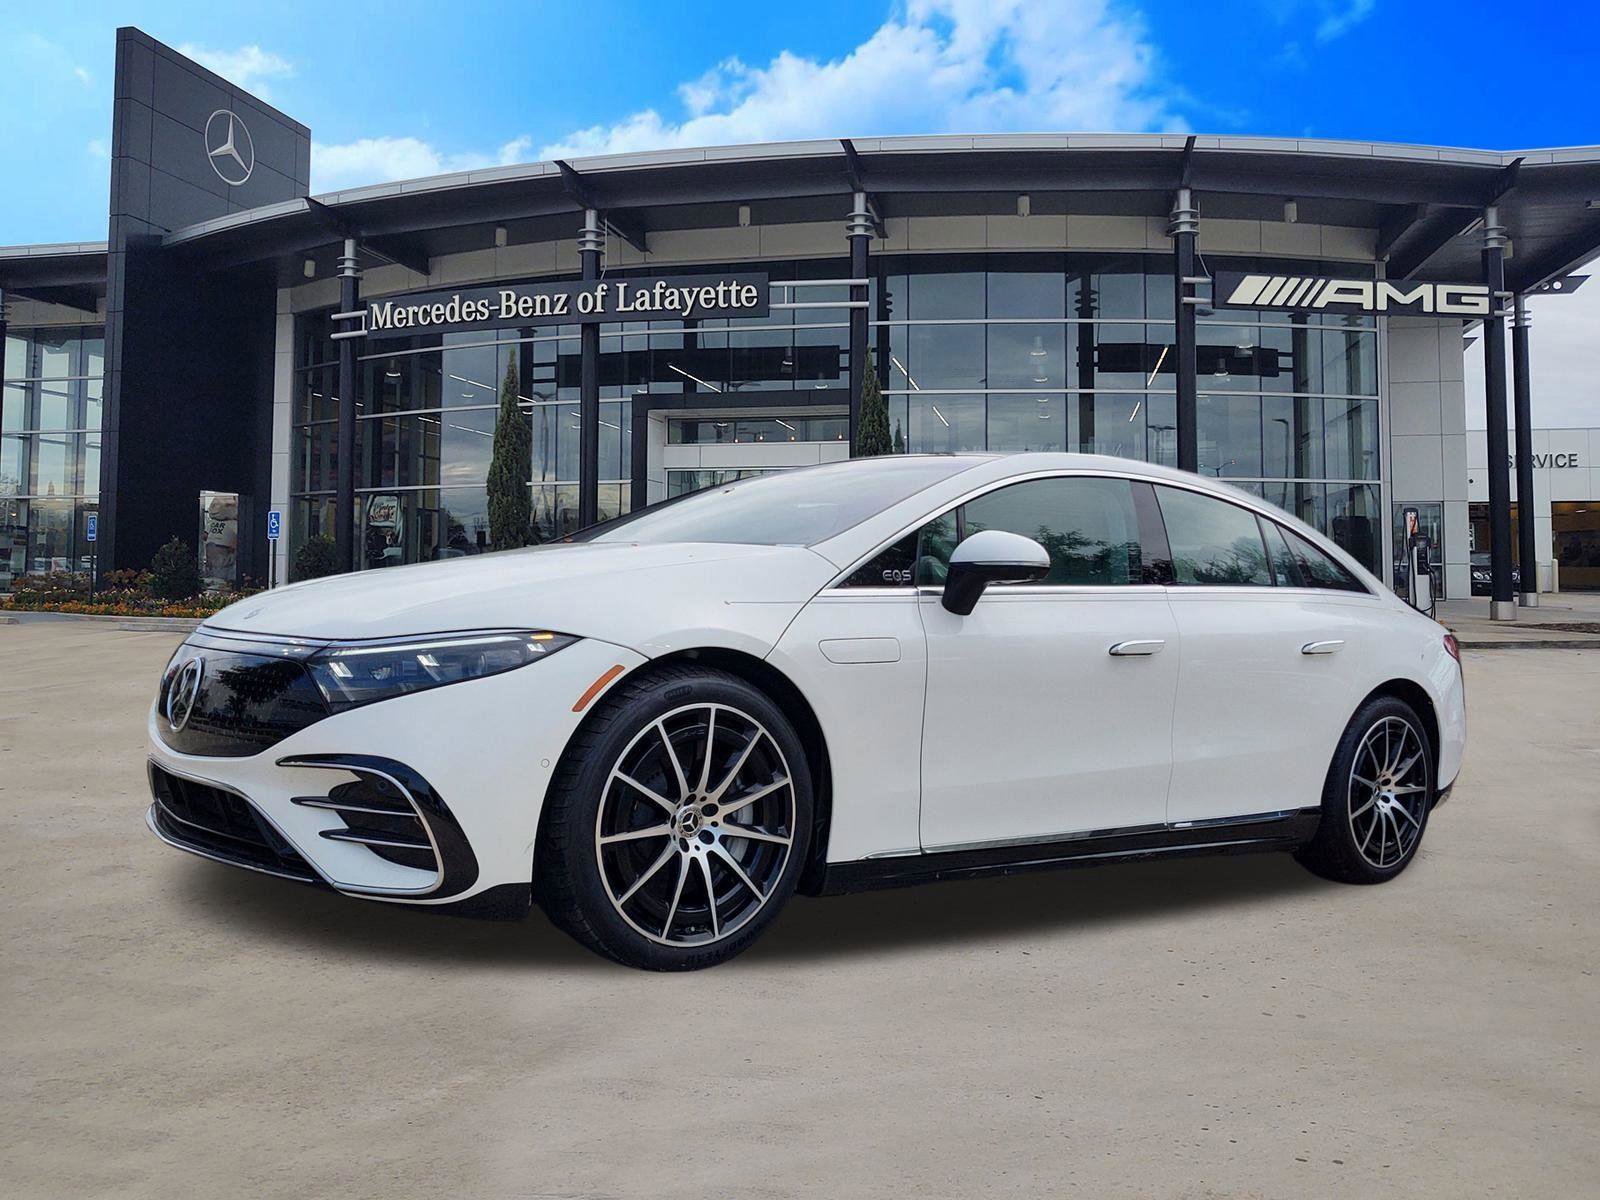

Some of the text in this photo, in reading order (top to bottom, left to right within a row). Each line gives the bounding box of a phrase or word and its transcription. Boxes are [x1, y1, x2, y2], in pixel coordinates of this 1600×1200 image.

[370, 279, 758, 330] Mercedes-Benz of Lafayette
[1313, 278, 1489, 314] AMG
[1506, 453, 1578, 468] SRVICE
[883, 570, 911, 581] EQS
